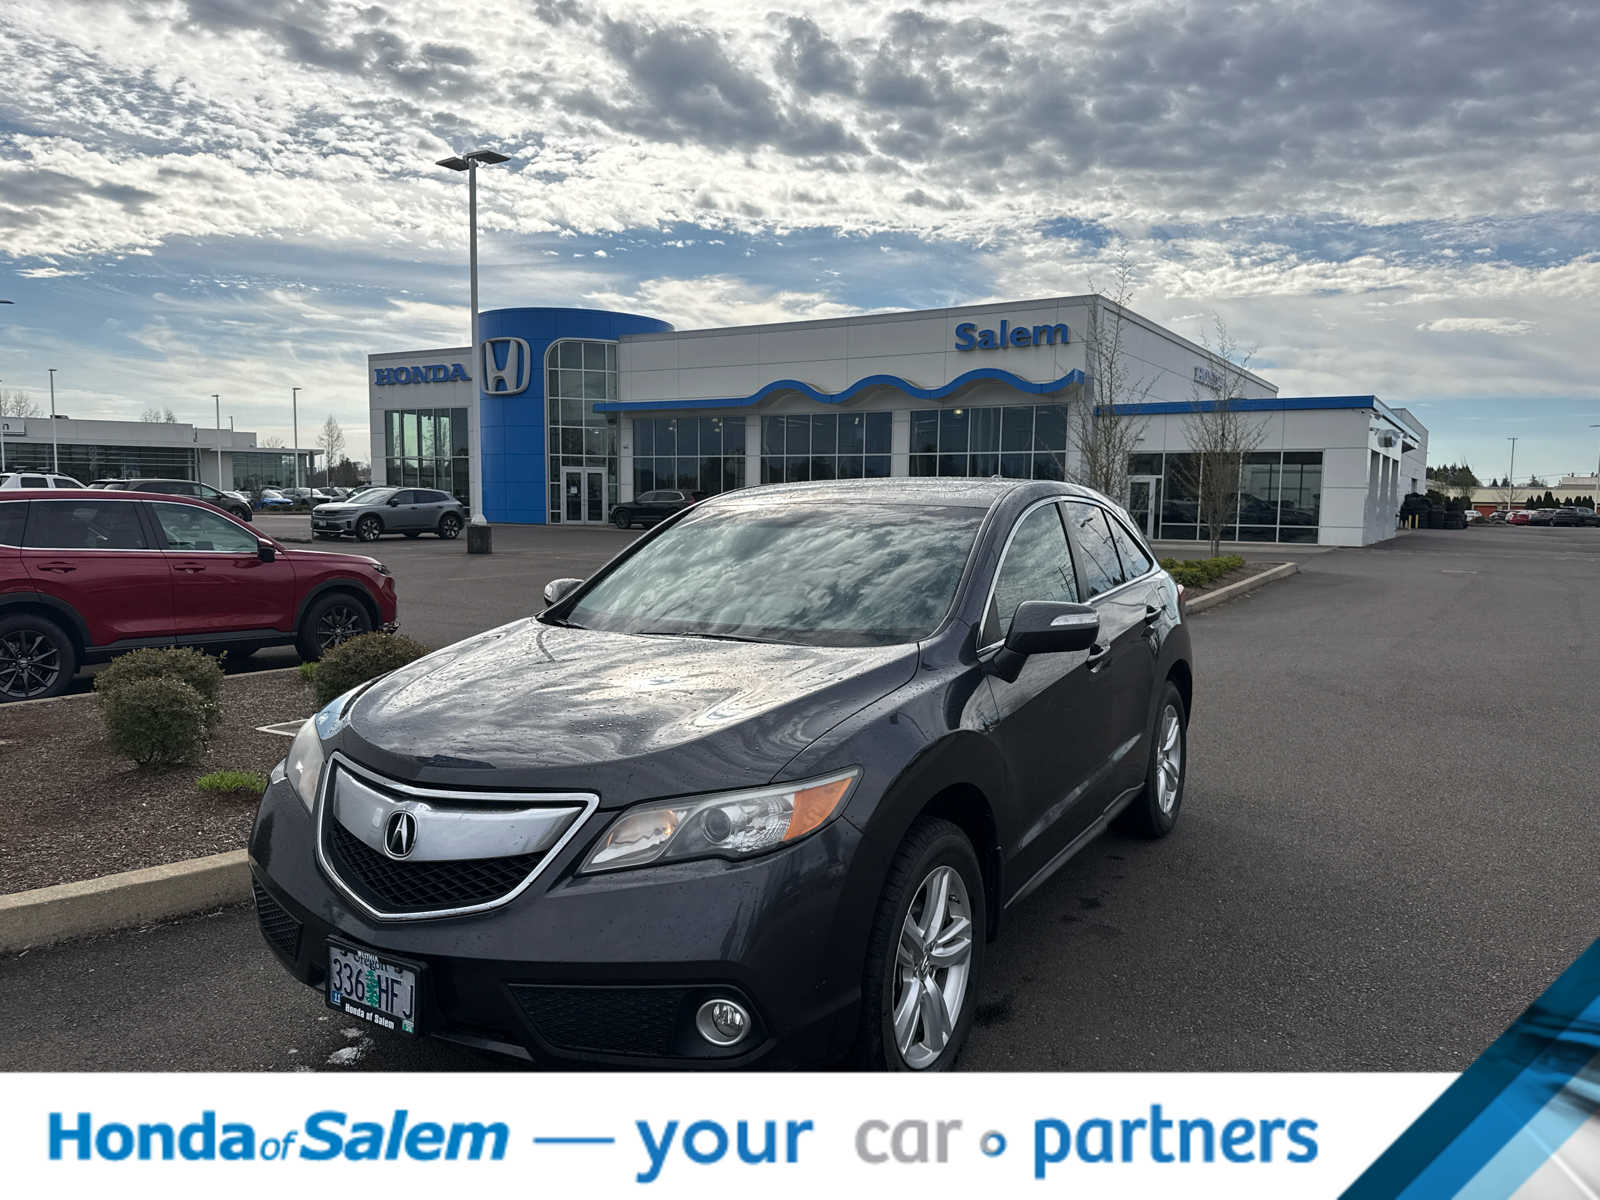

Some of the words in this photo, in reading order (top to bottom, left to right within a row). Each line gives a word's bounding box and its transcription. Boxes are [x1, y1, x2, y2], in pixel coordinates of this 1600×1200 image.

[955, 320, 1069, 351] Salem
[375, 363, 472, 385] HONDA
[333, 958, 365, 1002] 336
[345, 1003, 364, 1018] Honda
[374, 1014, 394, 1029] Salem
